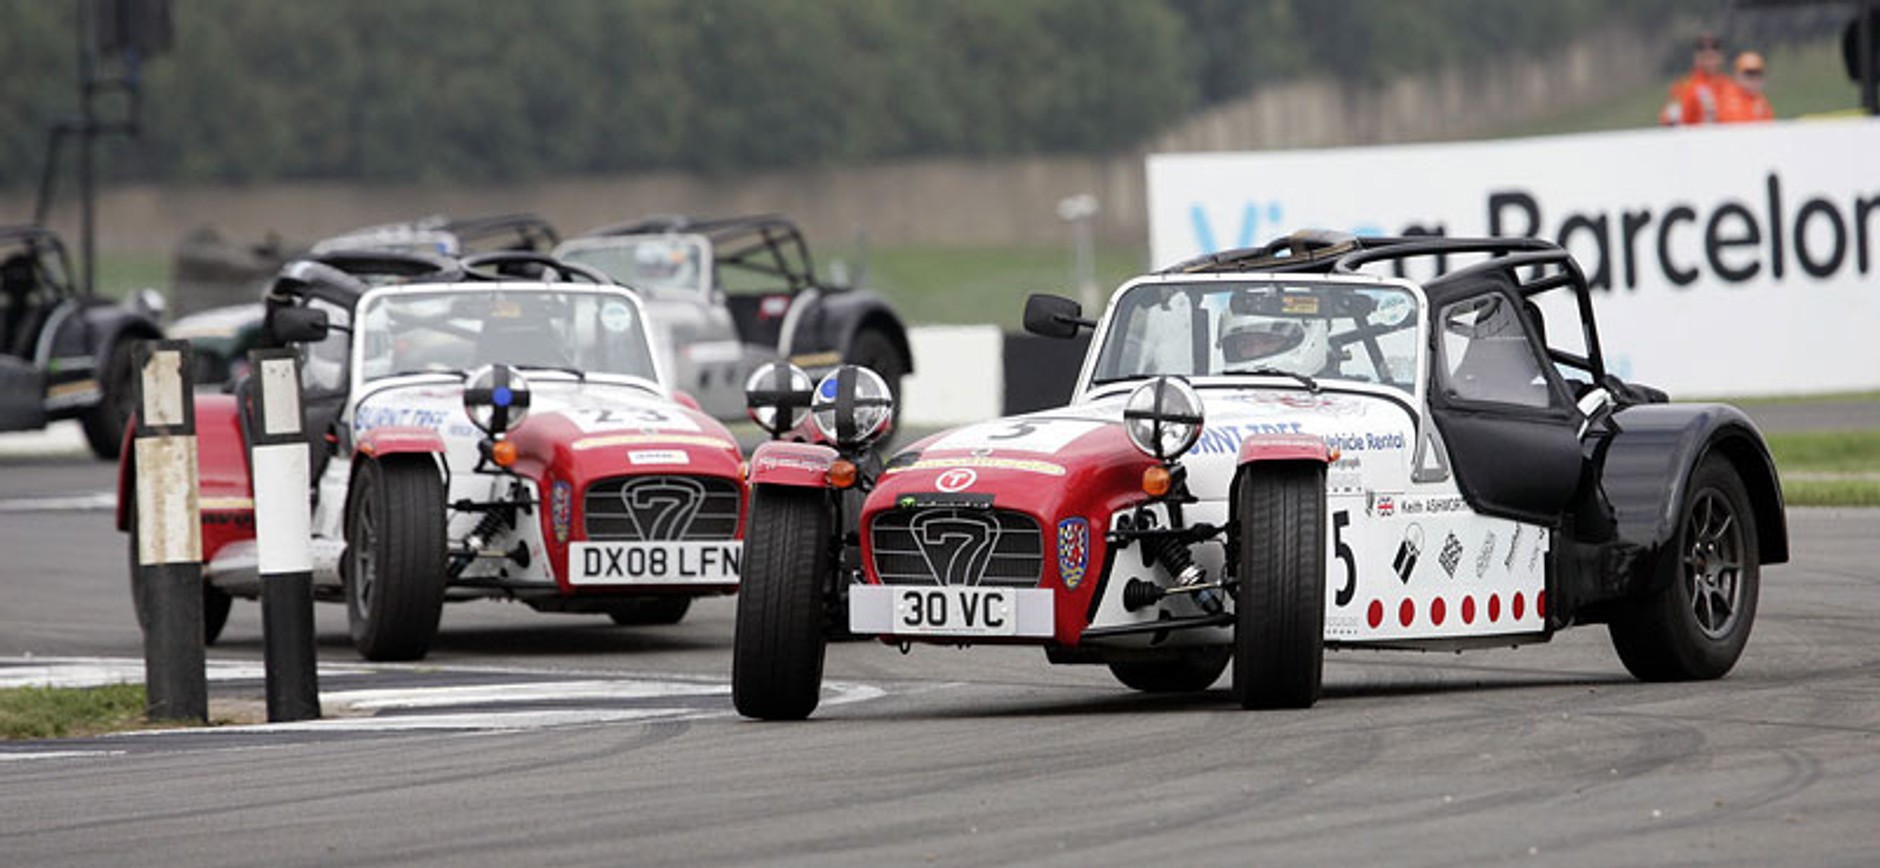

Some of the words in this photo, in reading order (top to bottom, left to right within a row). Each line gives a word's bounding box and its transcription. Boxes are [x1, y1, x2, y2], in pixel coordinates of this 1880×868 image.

[1366, 431, 1406, 450] Rental
[583, 547, 668, 577] DX08
[679, 547, 741, 577] LFN
[1332, 509, 1357, 607] 5
[902, 590, 948, 627] 30
[959, 591, 1005, 627] VC
